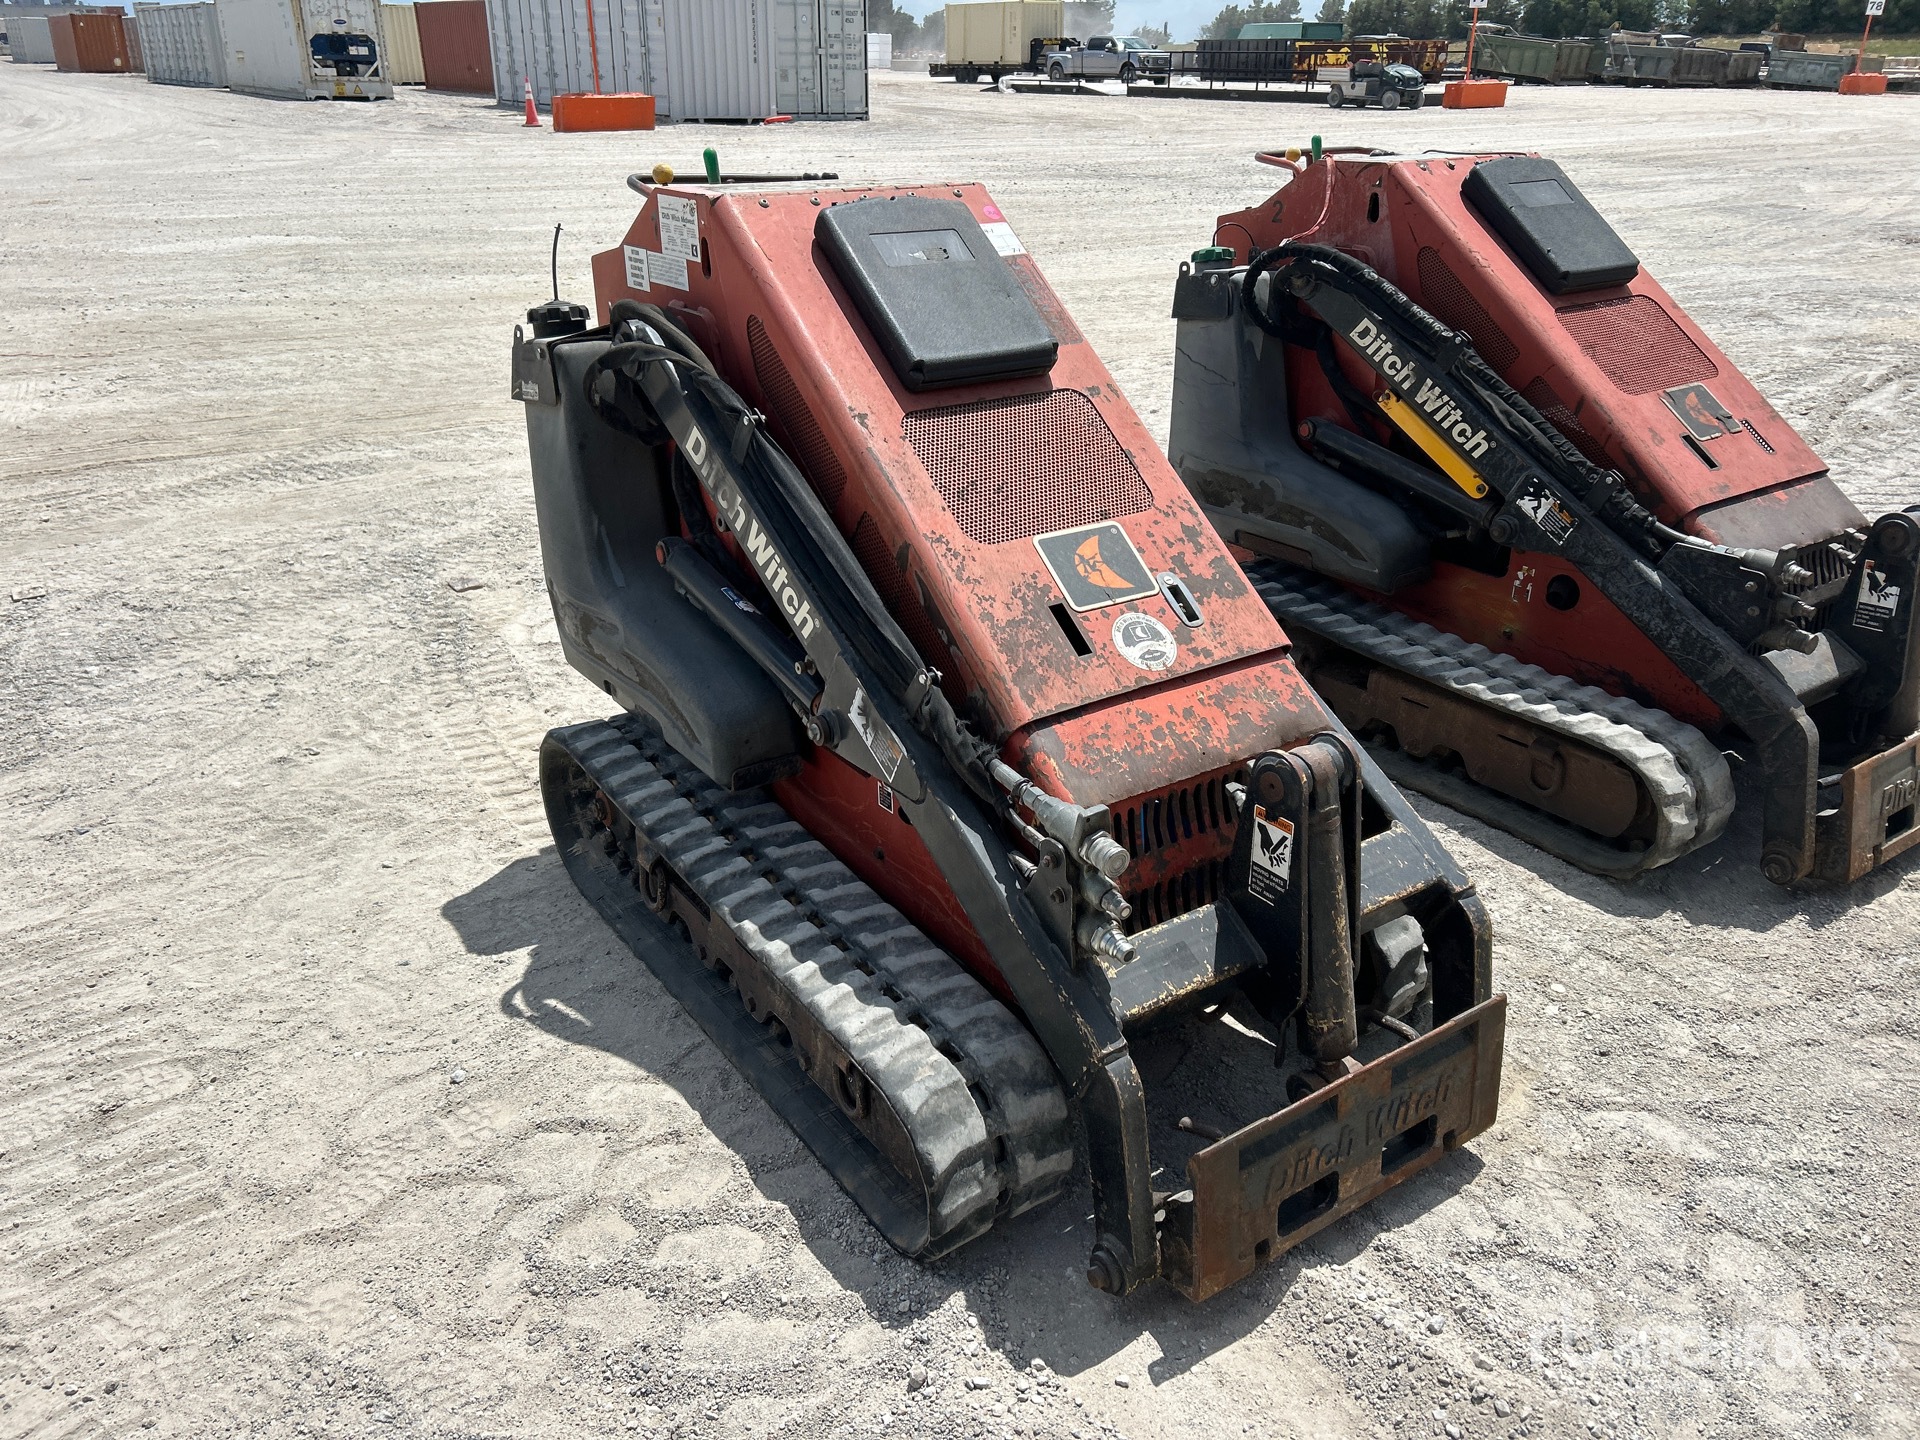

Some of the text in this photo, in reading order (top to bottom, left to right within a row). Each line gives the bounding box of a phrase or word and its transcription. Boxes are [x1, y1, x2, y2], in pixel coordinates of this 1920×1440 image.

[1869, 1, 1883, 11] 78
[1271, 200, 1284, 224] 2
[1349, 317, 1489, 459] Ditch Witch
[685, 425, 815, 640] Ditch Witch
[1880, 769, 1920, 816] Ditc
[1270, 874, 1284, 886] PARTS
[1264, 1072, 1451, 1201] Ditch Witch
